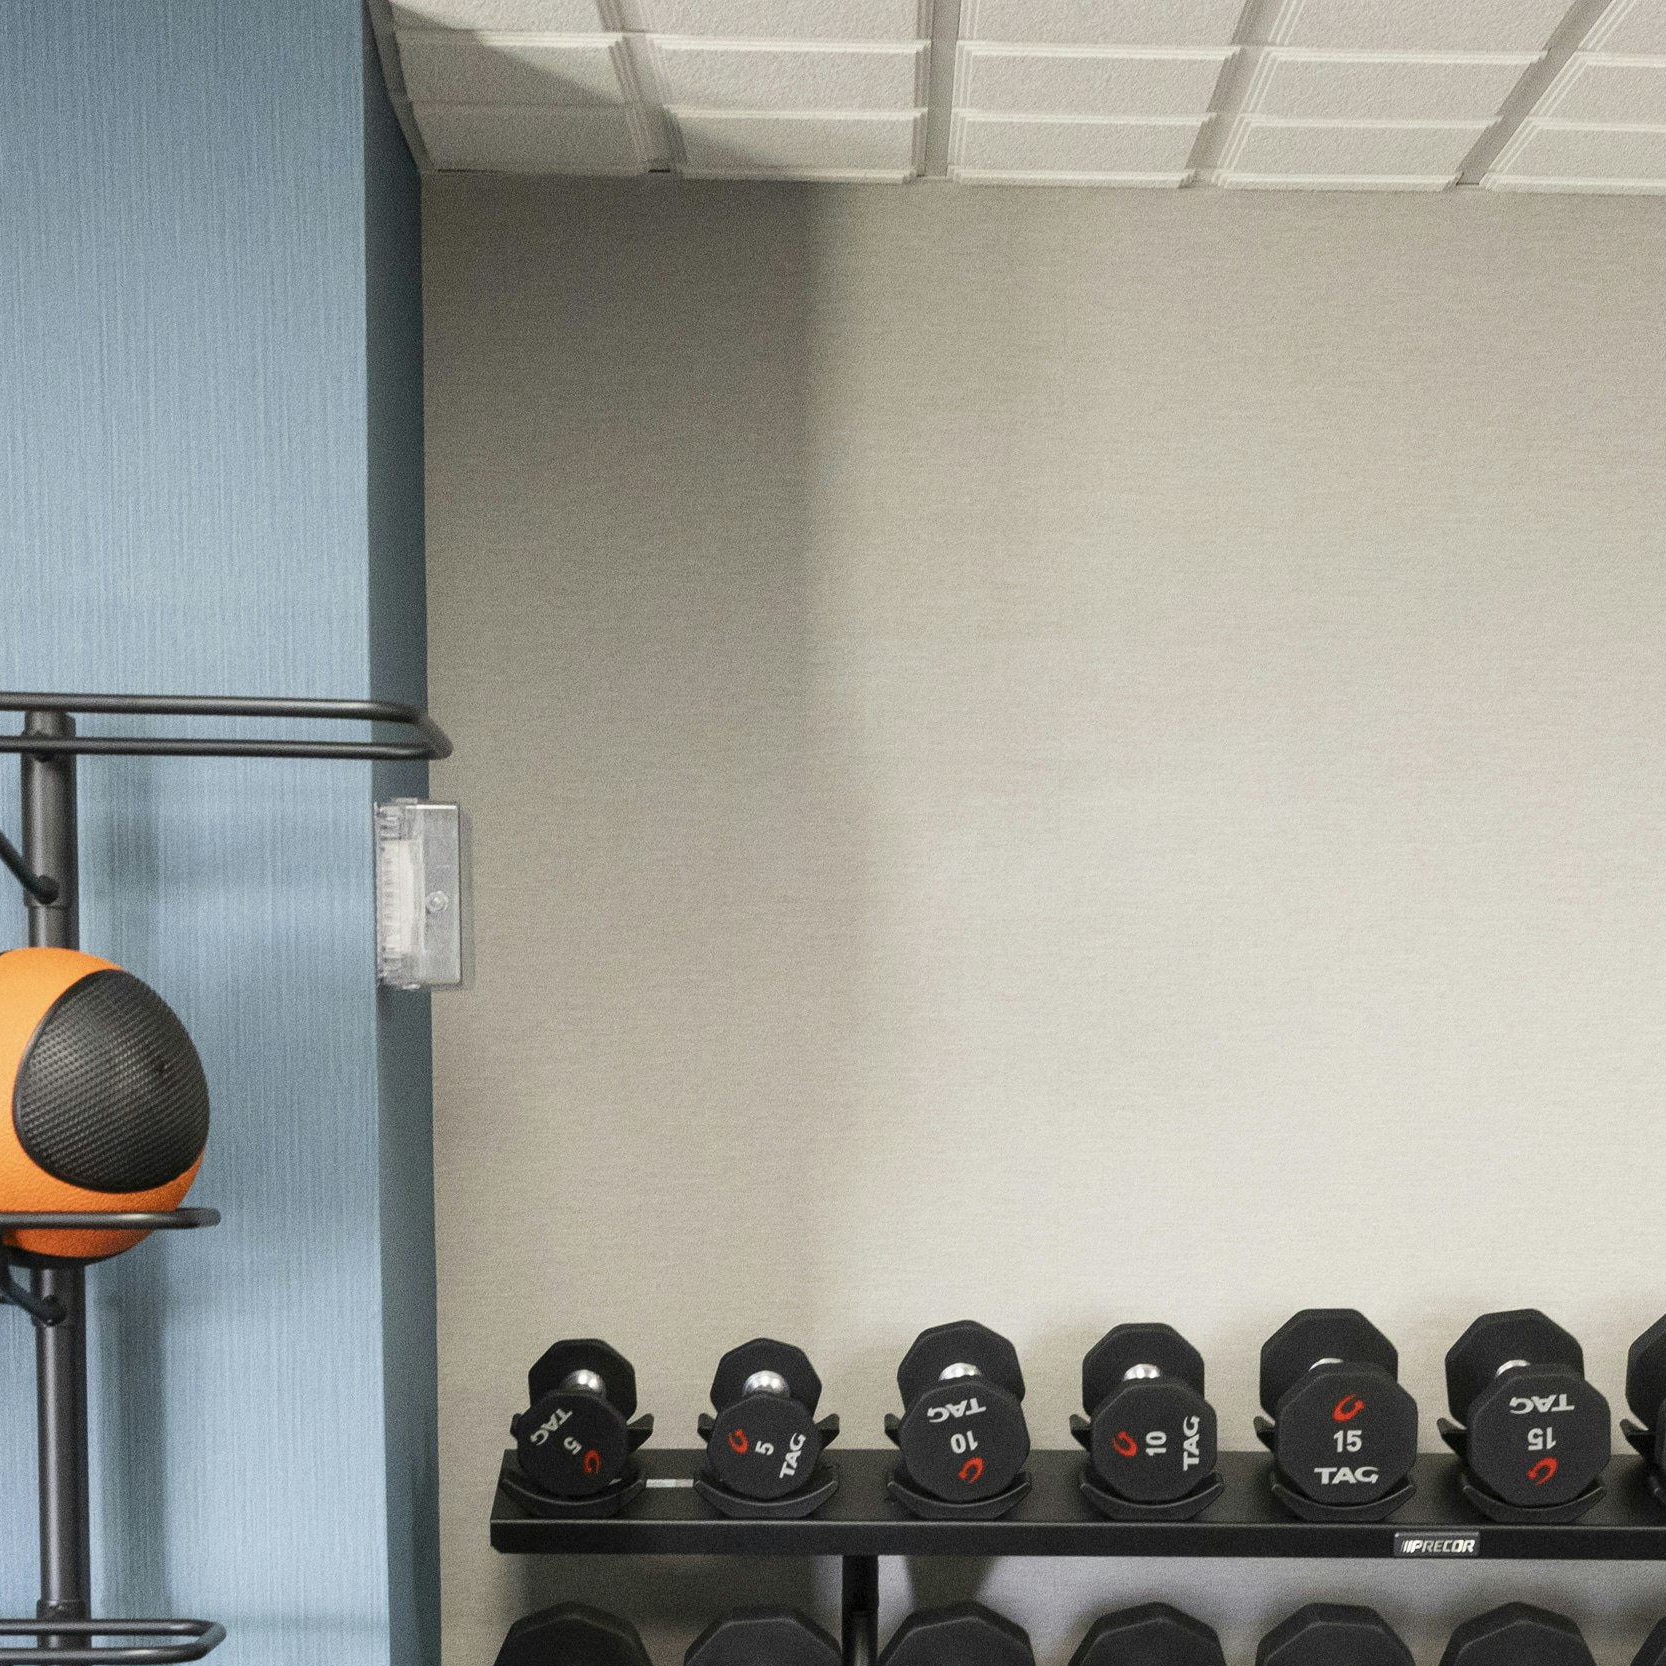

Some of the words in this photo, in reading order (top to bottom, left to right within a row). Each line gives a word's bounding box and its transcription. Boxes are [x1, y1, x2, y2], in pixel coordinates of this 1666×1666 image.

[926, 1397, 987, 1423] TAG
[1508, 1393, 1575, 1415] TAG
[530, 1408, 573, 1446] TAG
[1527, 1426, 1557, 1451] 15
[563, 1437, 582, 1455] 5
[754, 1440, 775, 1456] 5
[950, 1430, 979, 1454] 10
[1145, 1430, 1167, 1457] 10
[1182, 1415, 1200, 1472] TAG
[1333, 1429, 1363, 1453] 15
[778, 1432, 807, 1479] TAG
[1313, 1466, 1379, 1485] TAG
[1410, 1539, 1476, 1553] PRECOR
